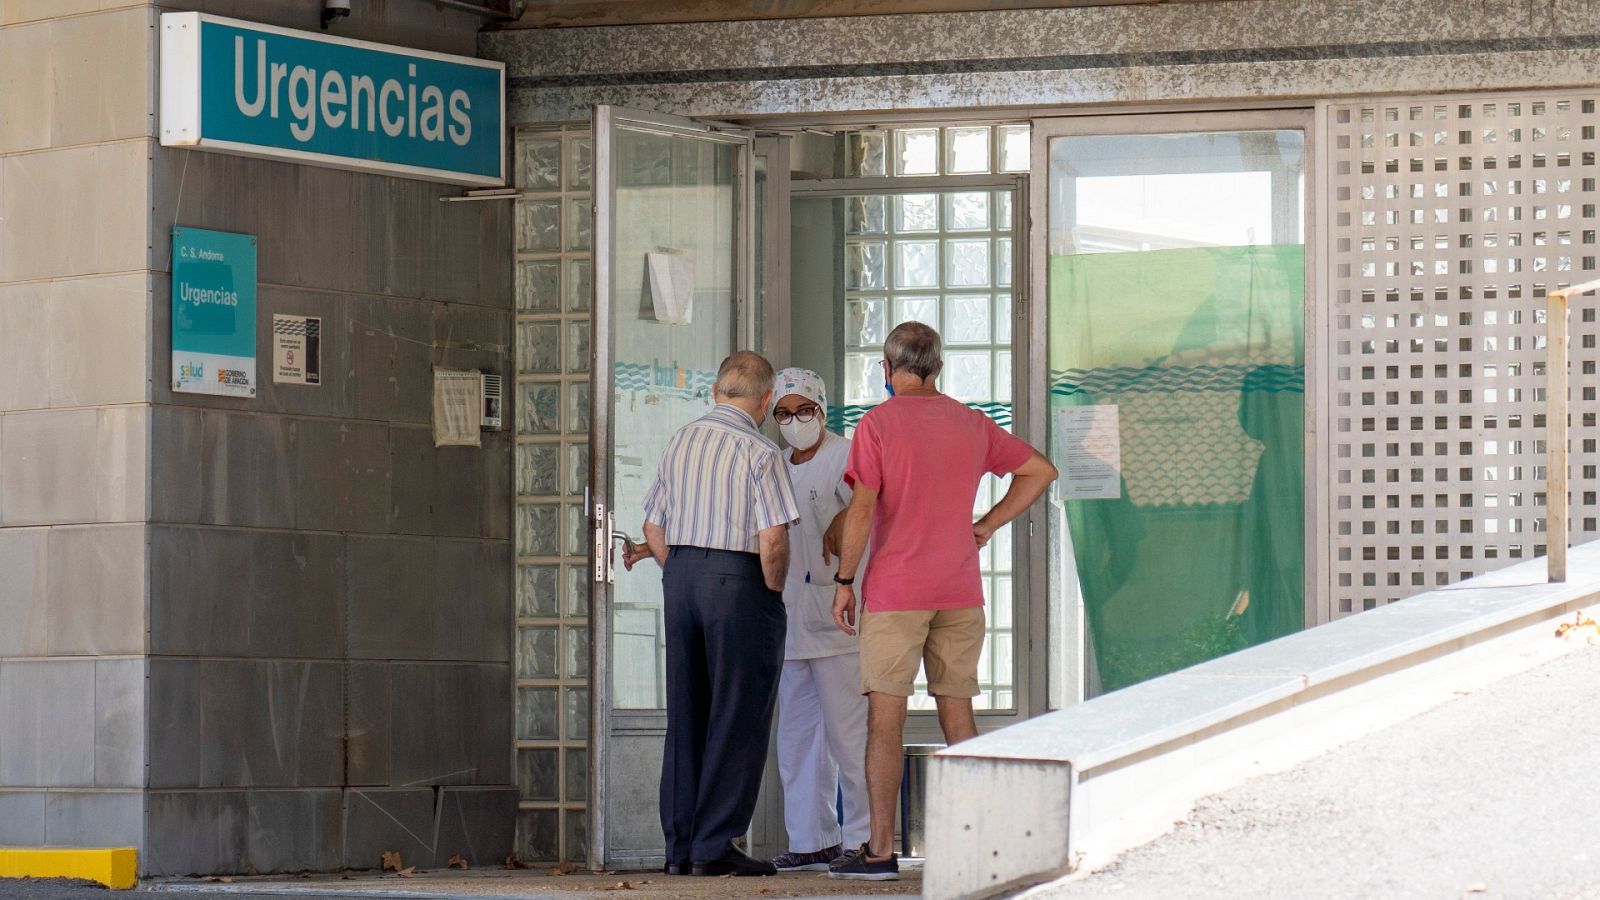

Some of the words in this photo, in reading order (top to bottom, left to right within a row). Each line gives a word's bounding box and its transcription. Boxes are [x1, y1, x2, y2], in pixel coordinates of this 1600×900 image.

[235, 35, 472, 146] Urgencias
[180, 246, 188, 257] C.
[190, 247, 197, 258] S.
[199, 248, 224, 261] Andorra
[180, 281, 238, 307] Urgencias
[181, 361, 203, 377] salud
[226, 369, 246, 377] GOBIERNO
